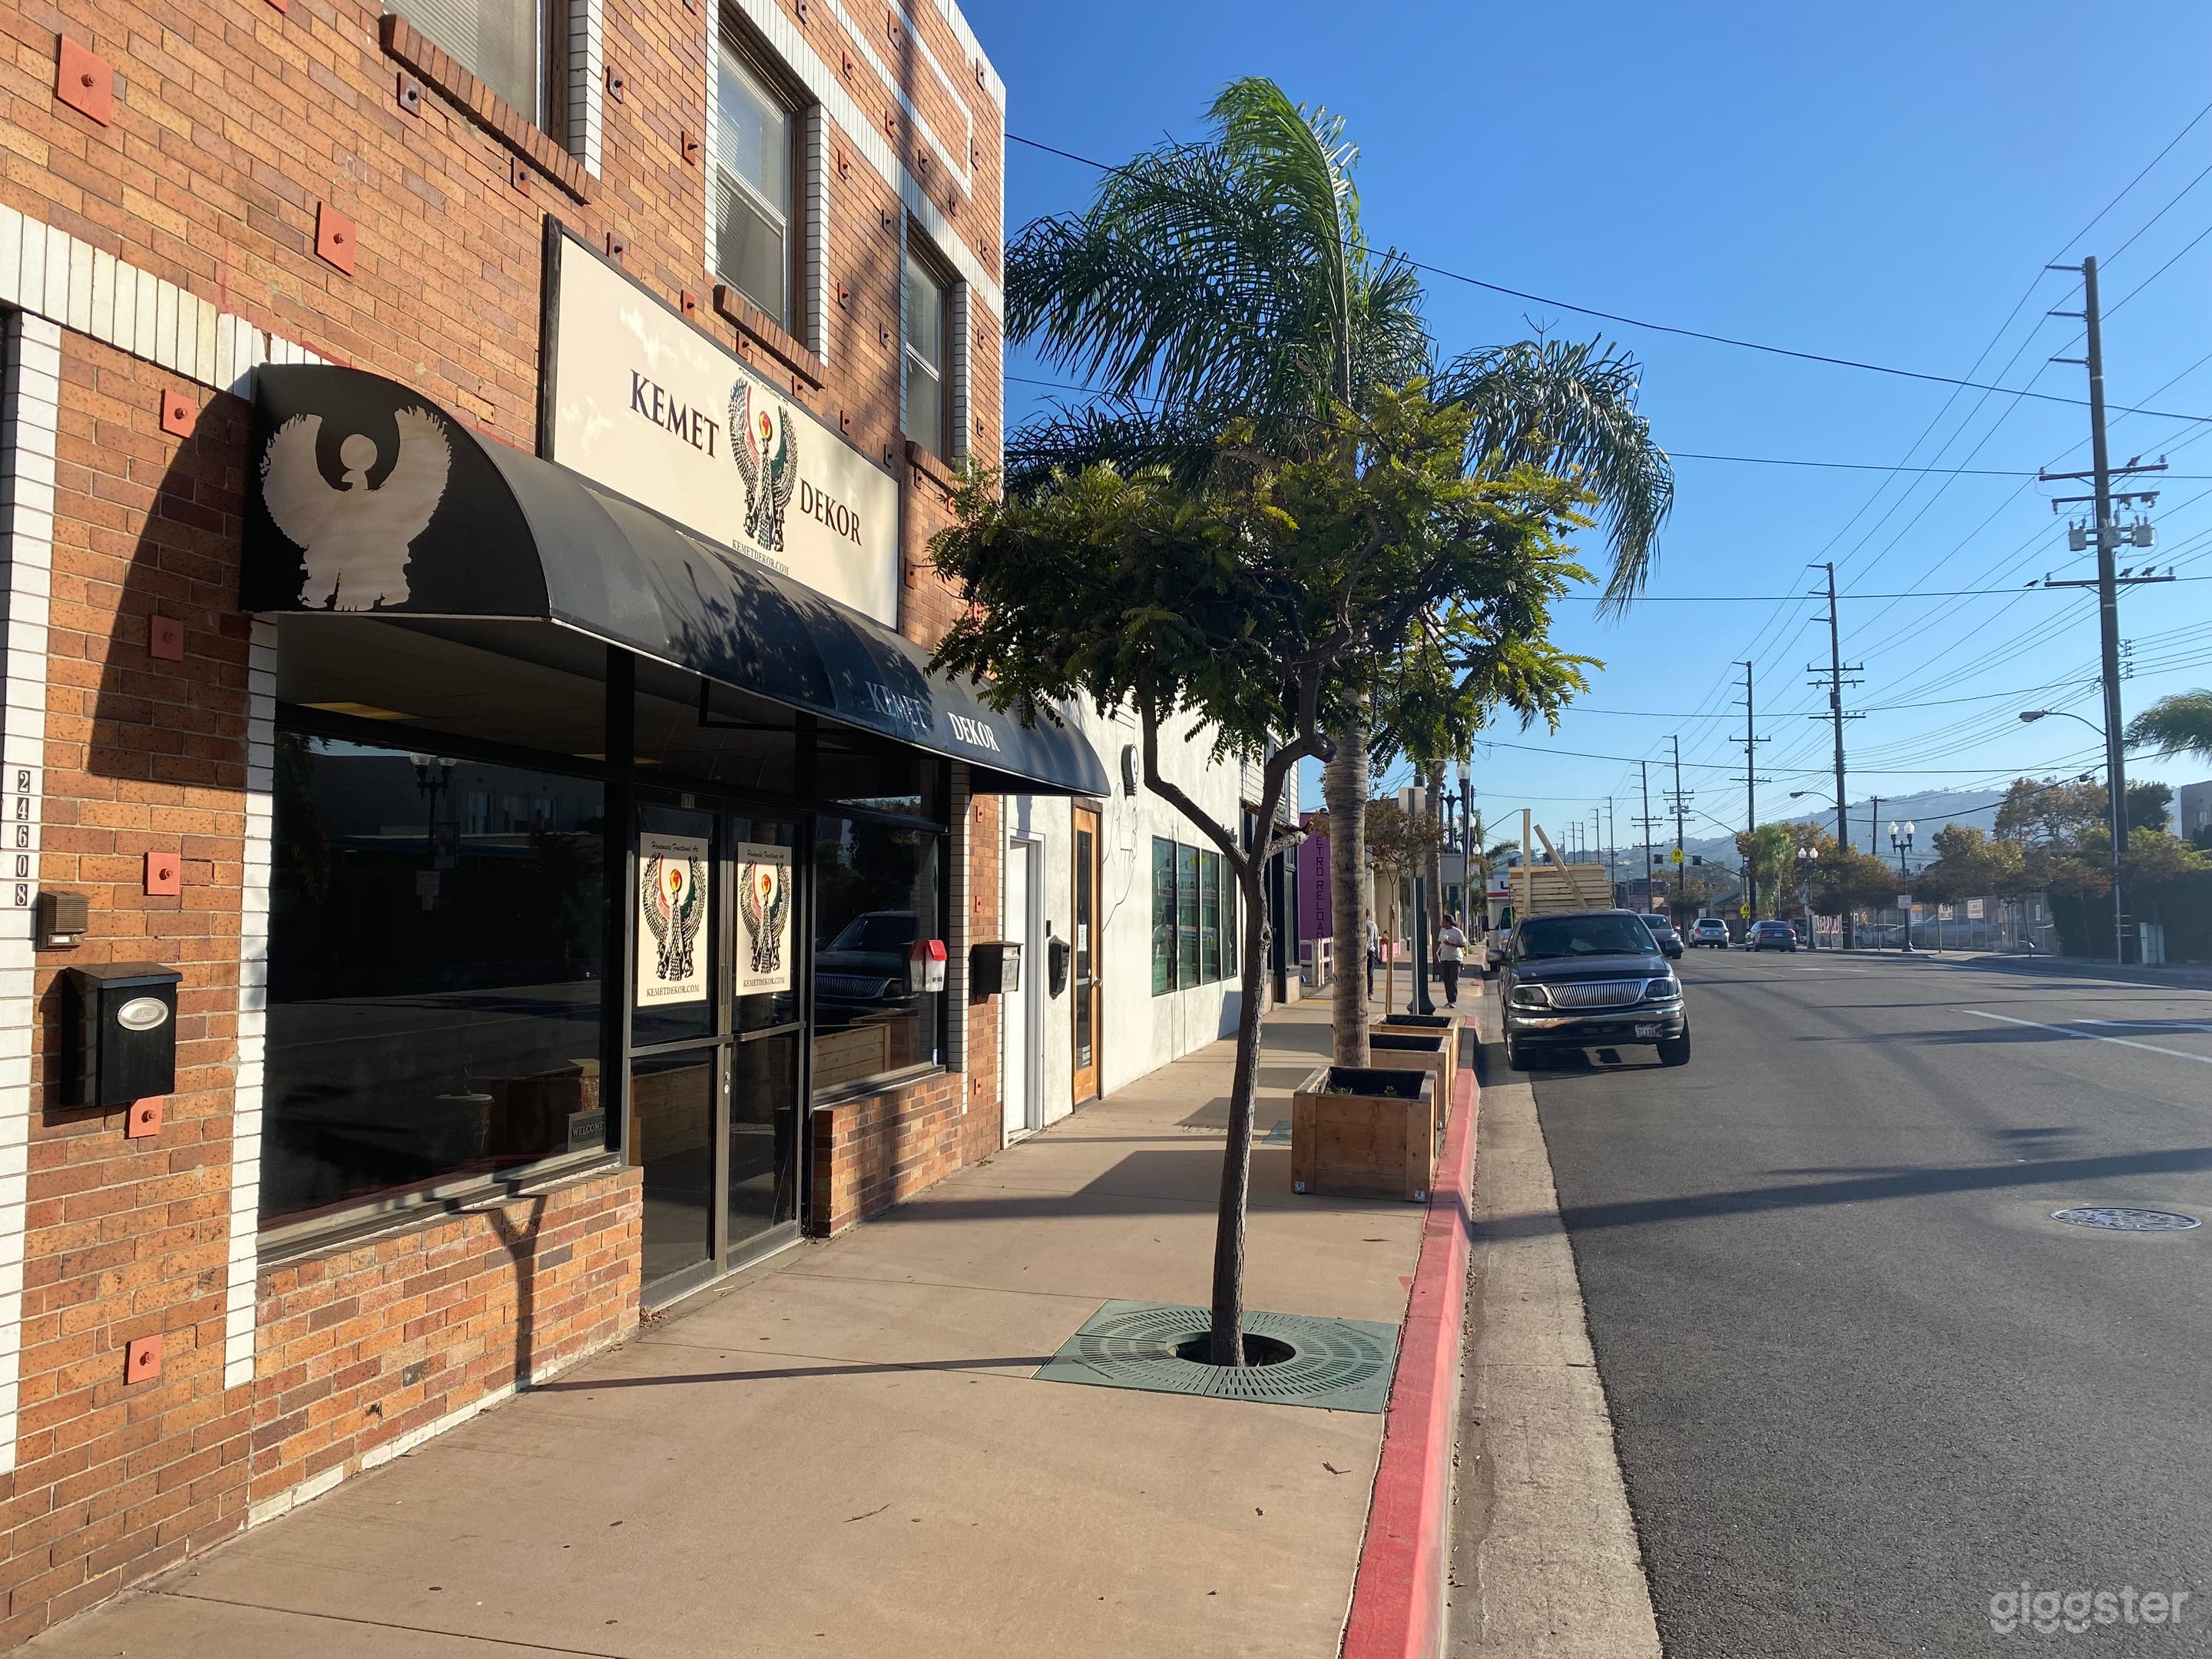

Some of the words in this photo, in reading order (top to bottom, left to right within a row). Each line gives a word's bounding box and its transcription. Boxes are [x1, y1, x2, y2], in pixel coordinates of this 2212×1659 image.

[629, 369, 720, 459] KEMET
[800, 477, 862, 546] DEKOR
[732, 539, 789, 575] KEMETDEKOR.COM
[864, 680, 926, 728] KEMET
[947, 711, 1001, 752] DEKOR
[15, 770, 30, 906] 24608
[1316, 836, 1324, 876] ETRO
[647, 985, 700, 997] KEMETDEKOR.COM
[743, 977, 785, 988] KEMETDEKOR.COM
[572, 1121, 604, 1137] WELCOME
